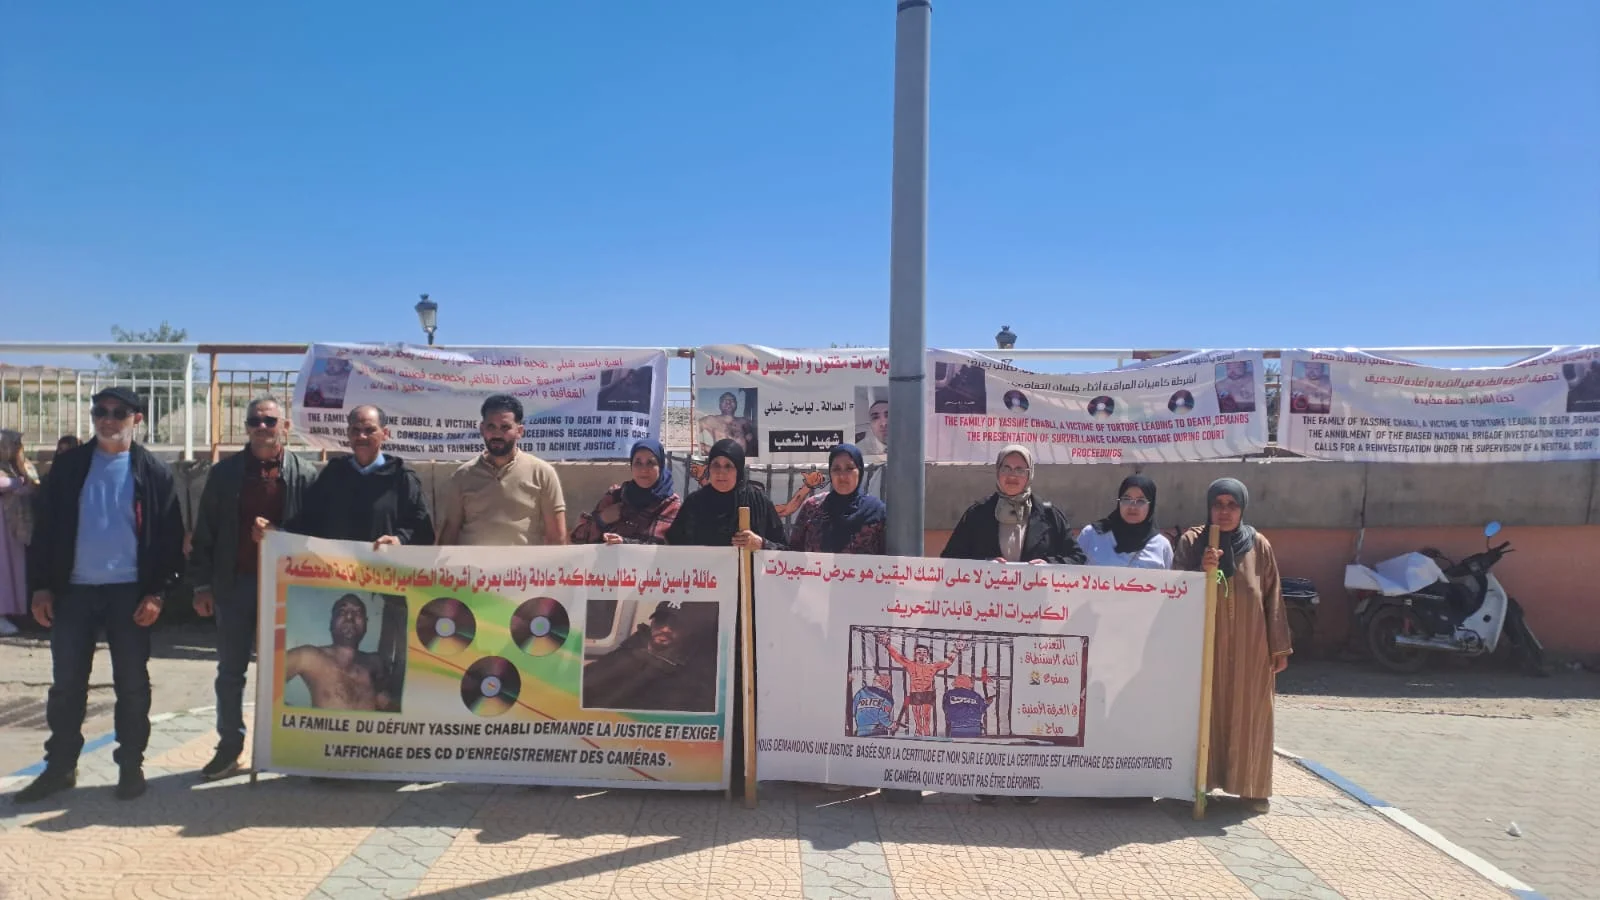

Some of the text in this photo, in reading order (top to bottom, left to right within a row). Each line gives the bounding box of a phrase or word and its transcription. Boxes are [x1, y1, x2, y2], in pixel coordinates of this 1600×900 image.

[705, 355, 744, 376] المسؤول
[745, 359, 759, 373] هو
[761, 357, 804, 376] البوليس
[806, 362, 812, 374] و
[815, 356, 848, 374] مقتول
[851, 355, 873, 369] مات
[1137, 377, 1170, 390] كاميرات
[1171, 373, 1197, 386] أشرطة
[764, 401, 784, 417] شبلي
[308, 413, 320, 422] THE
[436, 419, 441, 427] A
[445, 419, 477, 429] VICTIME
[529, 416, 561, 424] LEADING
[565, 416, 574, 424] TO
[579, 416, 601, 425] DEATH
[607, 416, 617, 425] AT
[620, 417, 633, 425] THE
[944, 416, 1211, 432] THE FAMILY OF YASSINE A VICTIME OF TORTURE LEADING TO DEATH
[1302, 416, 1547, 428] THE FAMILY OF YASSINE OF TORTURE LEADING TO
[397, 431, 443, 440] CONSIDERS
[568, 429, 612, 438] REGARDING
[615, 429, 629, 438] HIS
[774, 433, 809, 449] الشعب
[967, 430, 1225, 444] THE PRESENTATION OF SURVEILLANCE CAMERA FOOTAGE DURING COURT
[1308, 429, 1553, 440] THE ANNULMENT OF THE BIASED NATIONAL BRIGADE INVESTIGATION
[429, 442, 615, 453] AND FAIRNESS TO ACHIEVE JUSTICE
[1071, 448, 1122, 458] PROCEEDINGS
[1314, 442, 1338, 451] CALLS
[1340, 443, 1356, 451] FOR
[1365, 444, 1431, 453] REINVESTIGATION
[1434, 444, 1458, 453] UNDER
[1461, 444, 1473, 453] THE
[1523, 443, 1532, 452] OF
[1534, 443, 1539, 451] A
[285, 557, 333, 579] المحكمة
[359, 567, 382, 587] داخل
[383, 567, 437, 591] الكاميرات
[439, 565, 471, 592] أشرطة
[472, 569, 502, 593] بعرض
[502, 567, 527, 591] وذلك
[529, 568, 556, 588] عادلة
[558, 568, 605, 592] بمحاكمة
[607, 568, 637, 592] تطالب
[637, 568, 661, 595] شبلي
[663, 571, 690, 593] ياسين
[692, 569, 717, 589] عائلة
[765, 559, 1188, 599] نريد حكما عادلا مبنيا على اليقين لا على الشك اليقين هو عرض تسجيلات
[886, 600, 1069, 624] الكاميرات الغير قابلة للتحريف
[282, 714, 717, 740] LA FAMILLE DU DÉFUNT YASSINE CHABLI DEMANDE LA JUSTICE ET EXIGE
[324, 744, 604, 764] L'AFFICHAGE DES CD D'ENREGISTREMENT DES
[773, 739, 1173, 770] DEMANDONS UNE JUSTICE BASÉE SUR LA CERTITUDE ET NON SUR LE DOUTE LA CERTITUDE EST DES ENREGISTREMENTS
[884, 769, 988, 788] DE POUVENT PAS
